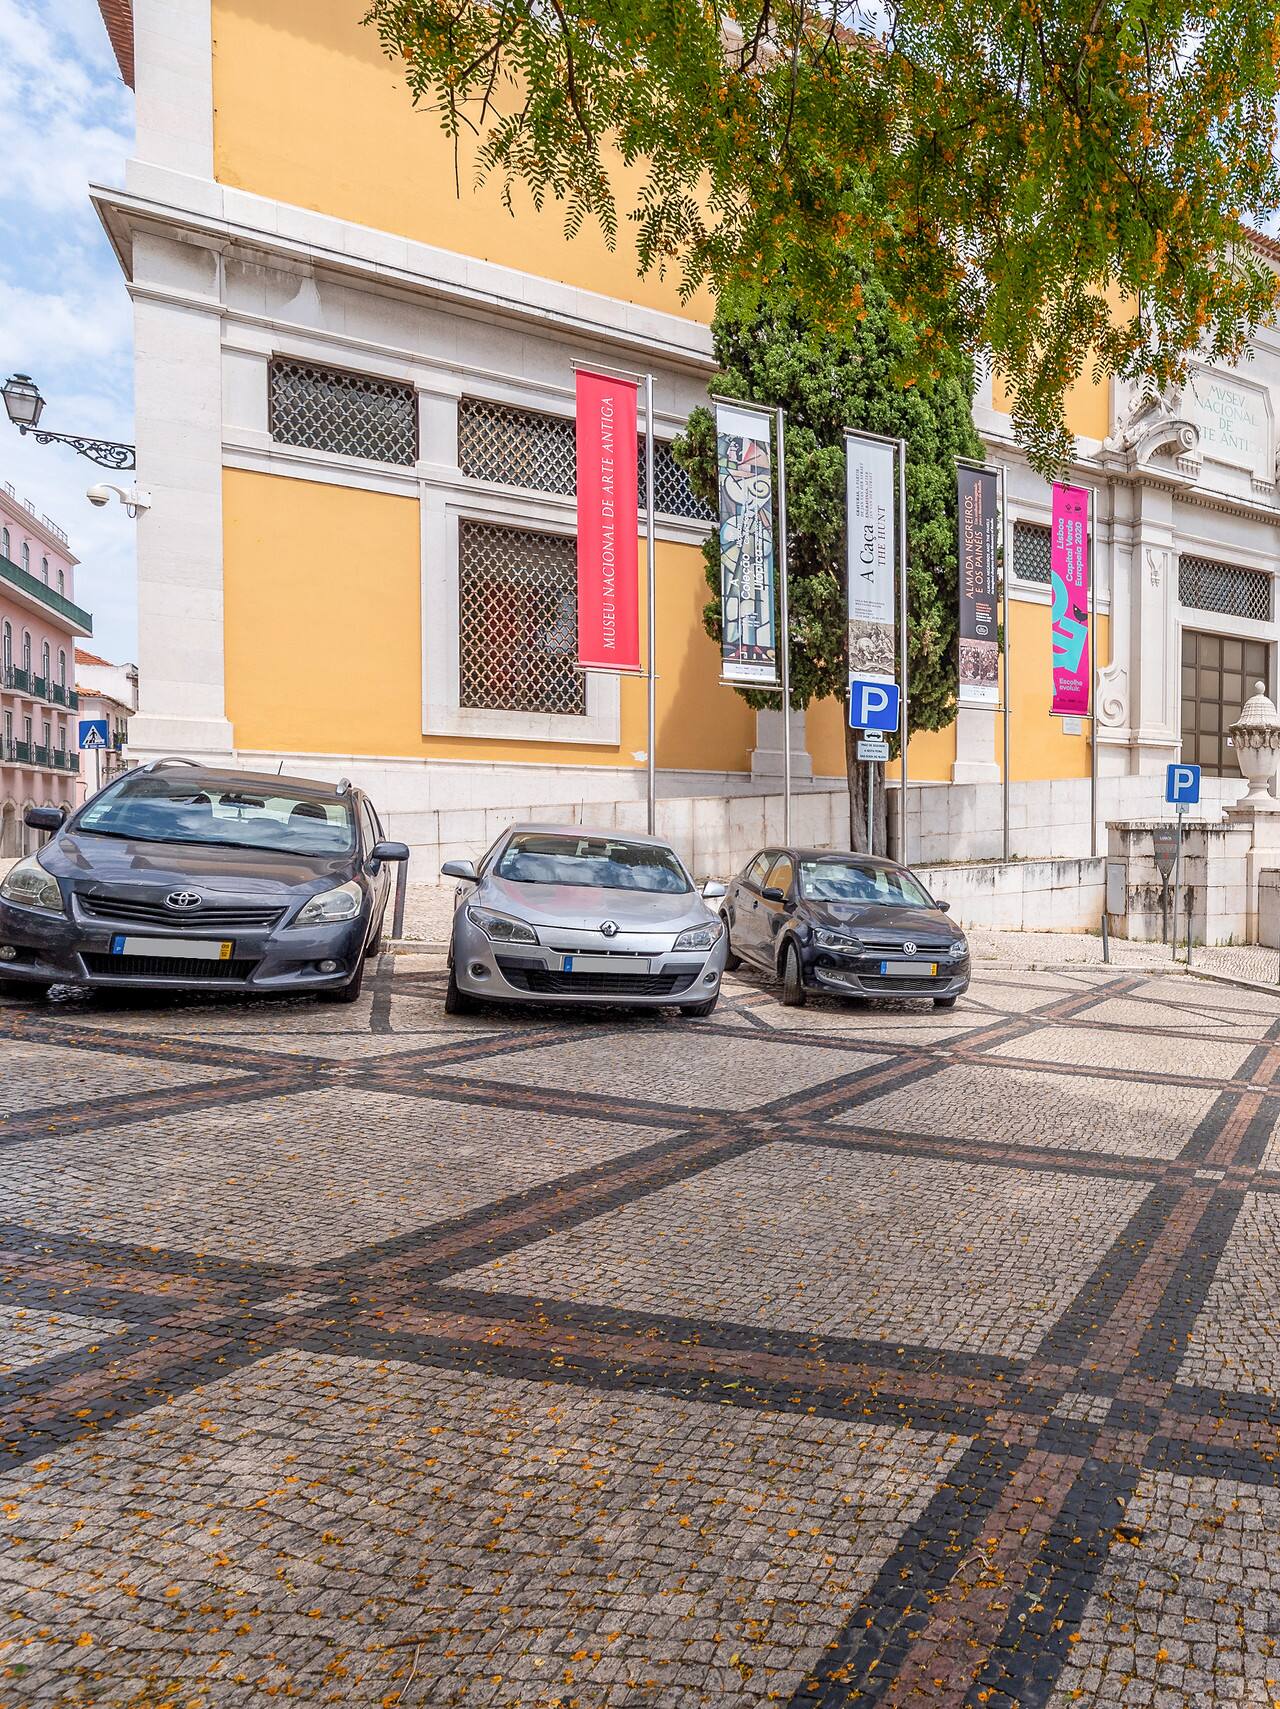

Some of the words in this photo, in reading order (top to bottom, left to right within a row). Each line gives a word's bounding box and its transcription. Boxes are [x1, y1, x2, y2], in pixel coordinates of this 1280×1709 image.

[600, 396, 614, 453] ANTIGA
[1194, 397, 1260, 427] NACIONAL
[1219, 417, 1233, 432] DE
[1196, 424, 1216, 441] RTE
[1220, 432, 1266, 457] ANTI
[601, 457, 614, 495] ARTE
[601, 499, 614, 518] DE
[877, 505, 886, 540] HUNT
[964, 495, 973, 552] NEGREIROS
[859, 524, 876, 564] Caça
[973, 531, 983, 568] PAINÉIS
[1065, 519, 1073, 547] Verde
[1075, 521, 1083, 545] 2020
[601, 523, 615, 597] NACIONAL
[753, 549, 764, 591] Utópica
[877, 543, 886, 567] THE
[1065, 548, 1074, 583] Capital
[1075, 545, 1083, 587] Europeia
[730, 578, 739, 587] A
[739, 553, 752, 600] Coleção
[860, 570, 874, 584] A
[965, 553, 974, 599] ALMADA
[975, 571, 984, 585] OS
[602, 602, 615, 649] MUSEU
[861, 686, 888, 724] P
[1173, 768, 1194, 799] P
